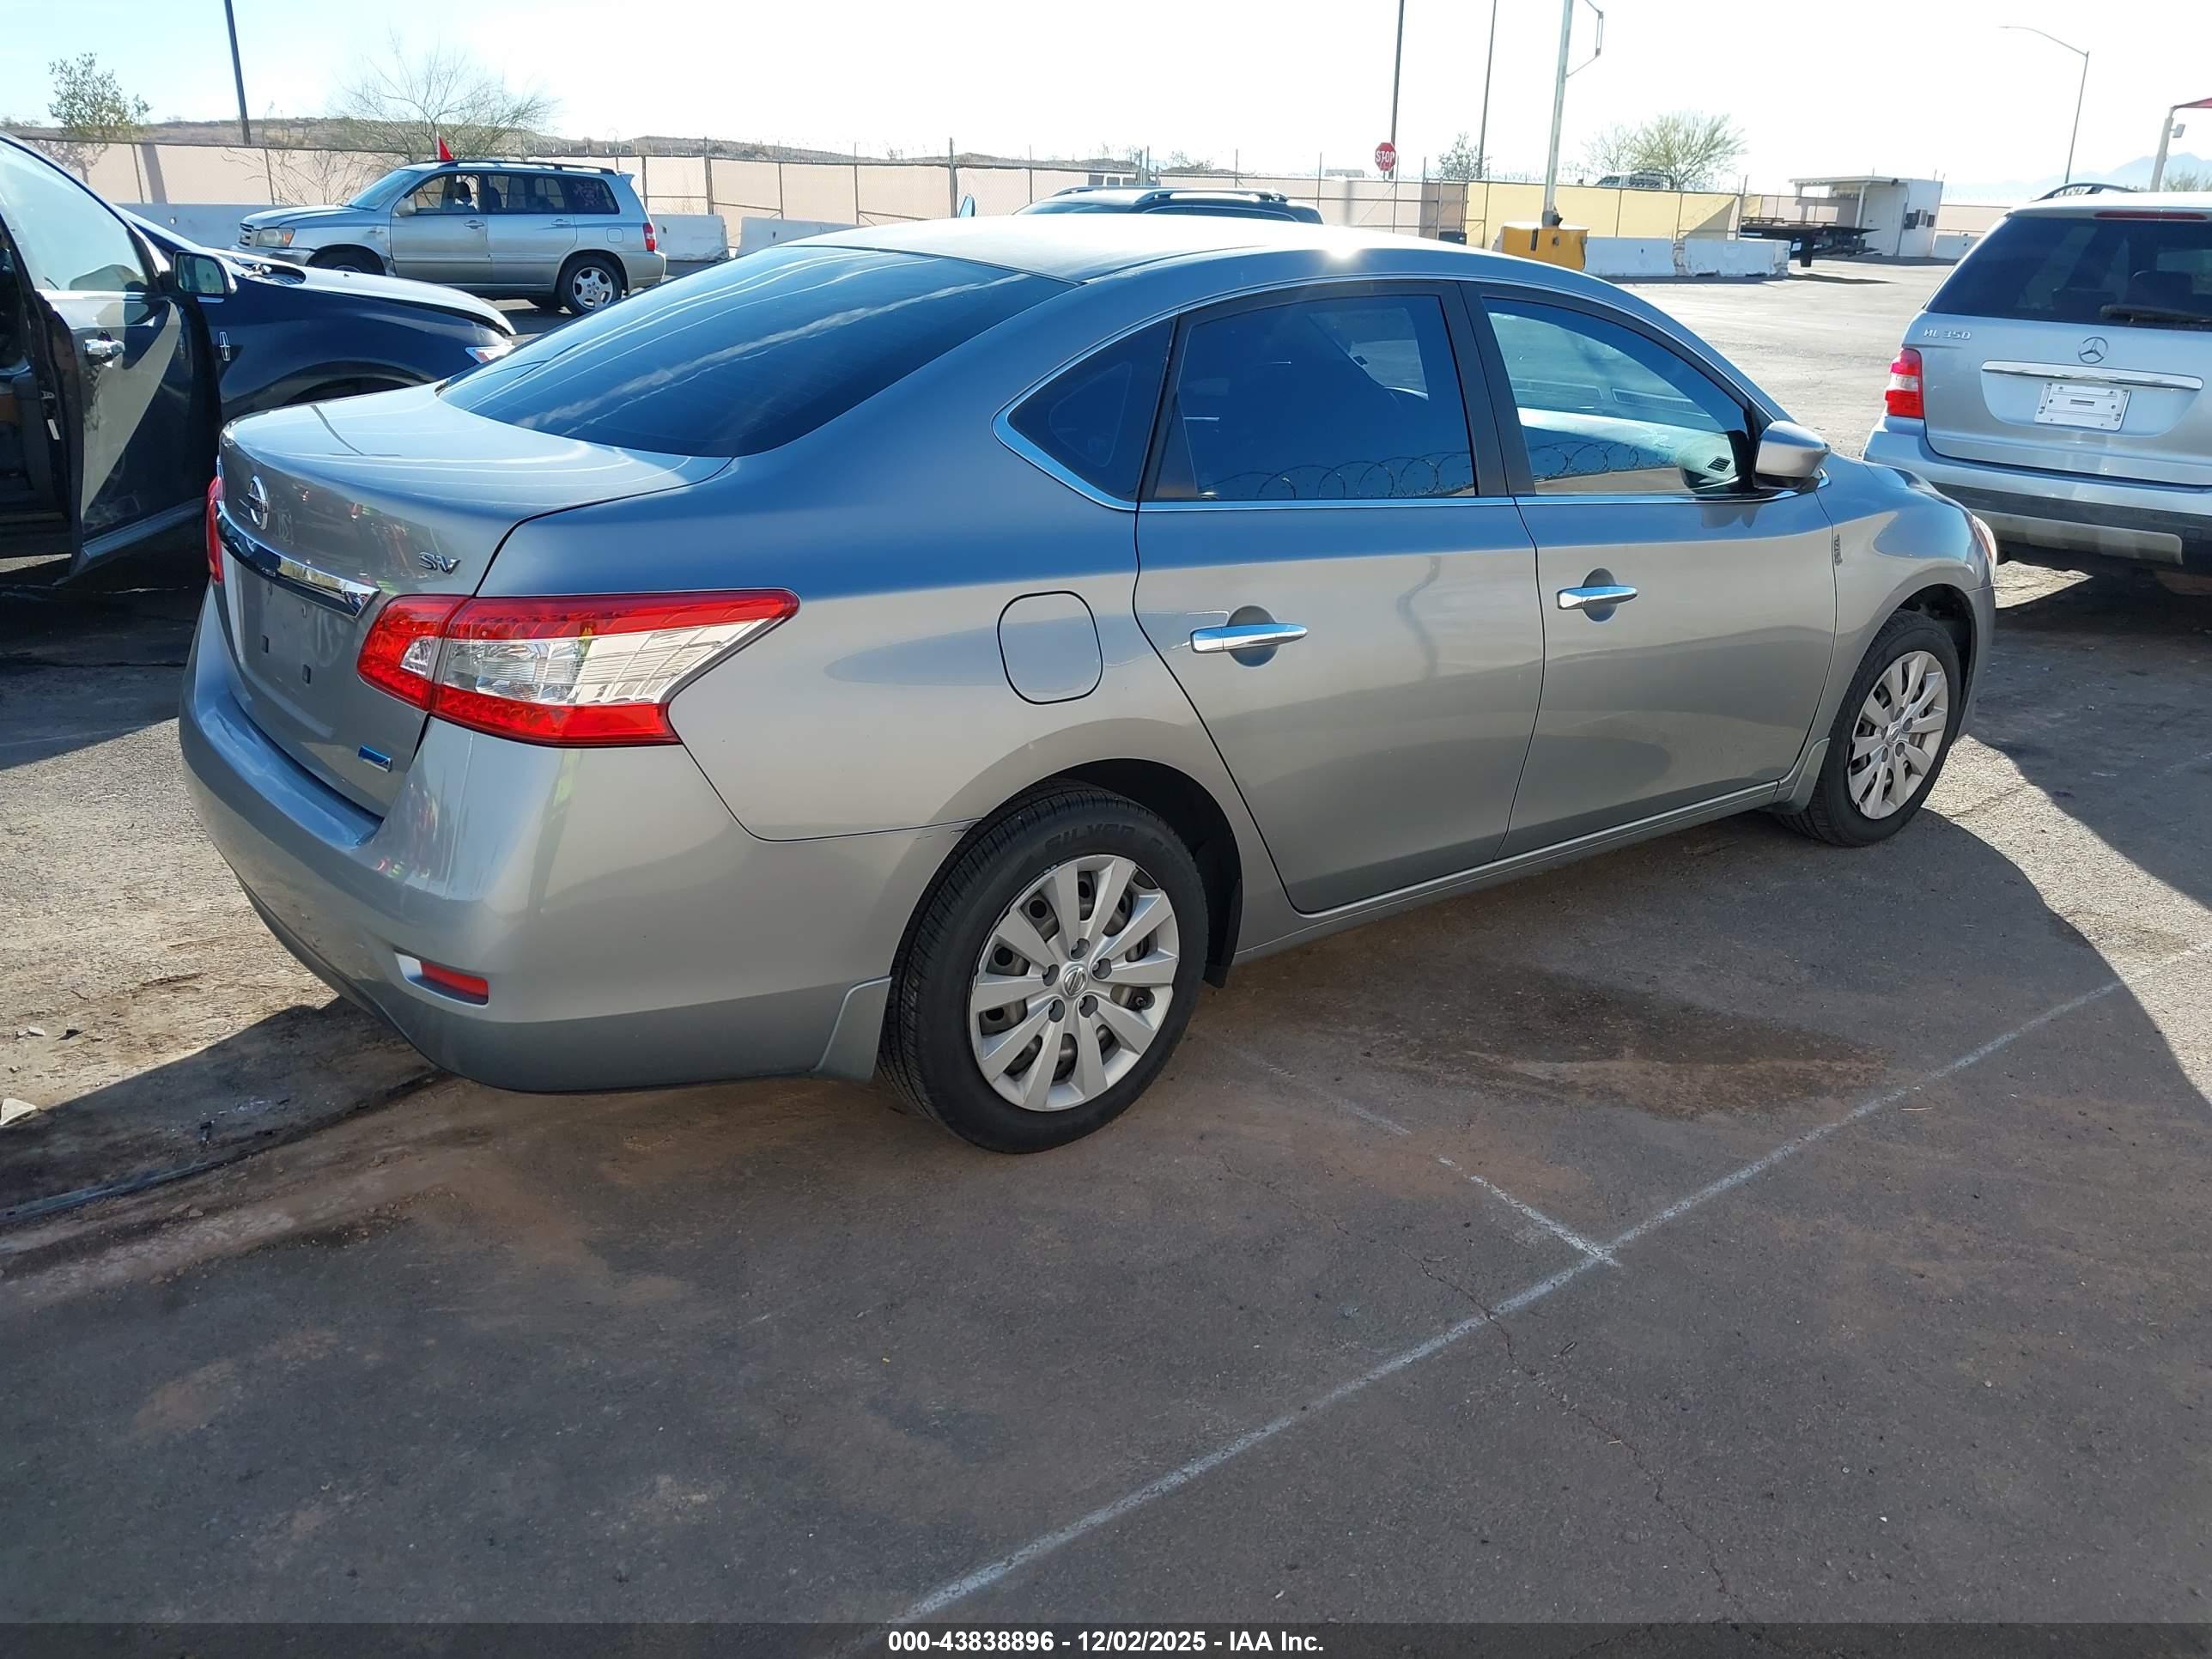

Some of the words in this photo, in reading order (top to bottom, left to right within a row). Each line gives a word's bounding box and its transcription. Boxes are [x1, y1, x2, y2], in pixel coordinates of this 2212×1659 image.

[1376, 150, 1395, 163] STOP
[1923, 329, 1939, 338] ML
[1943, 330, 1972, 341] 350
[419, 551, 461, 574] SV
